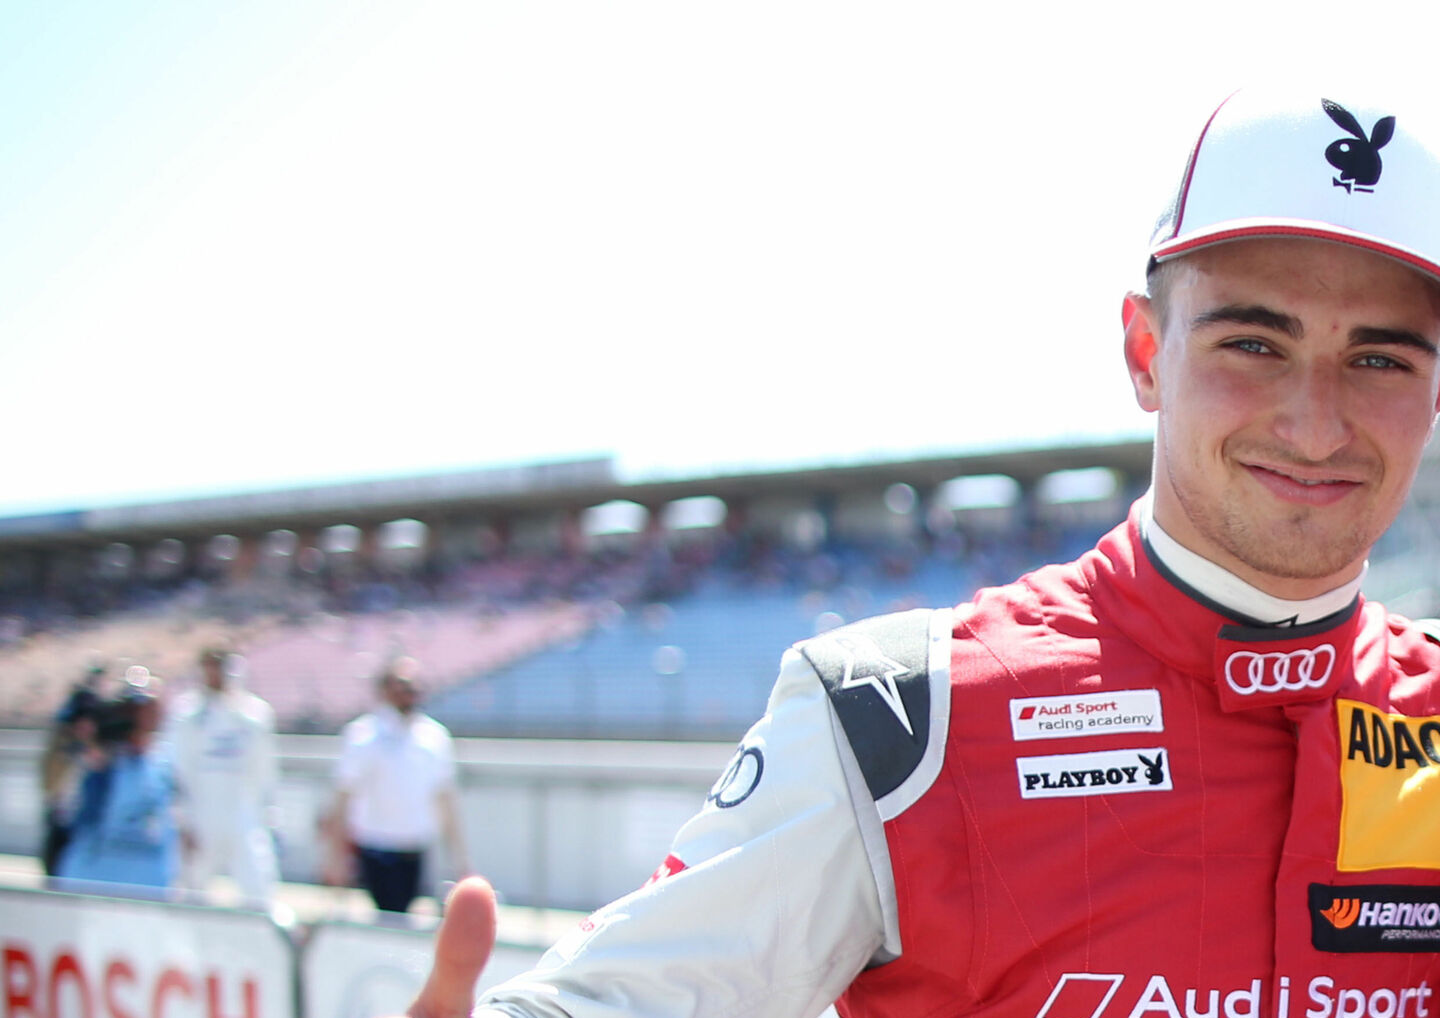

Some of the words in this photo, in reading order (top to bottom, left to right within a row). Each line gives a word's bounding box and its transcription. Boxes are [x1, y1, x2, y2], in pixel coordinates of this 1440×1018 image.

[1038, 703, 1072, 716] Audi
[1076, 701, 1118, 715] Sport
[1039, 718, 1084, 731] racing
[1088, 714, 1154, 728] academy
[1024, 766, 1139, 791] PLAYBOY
